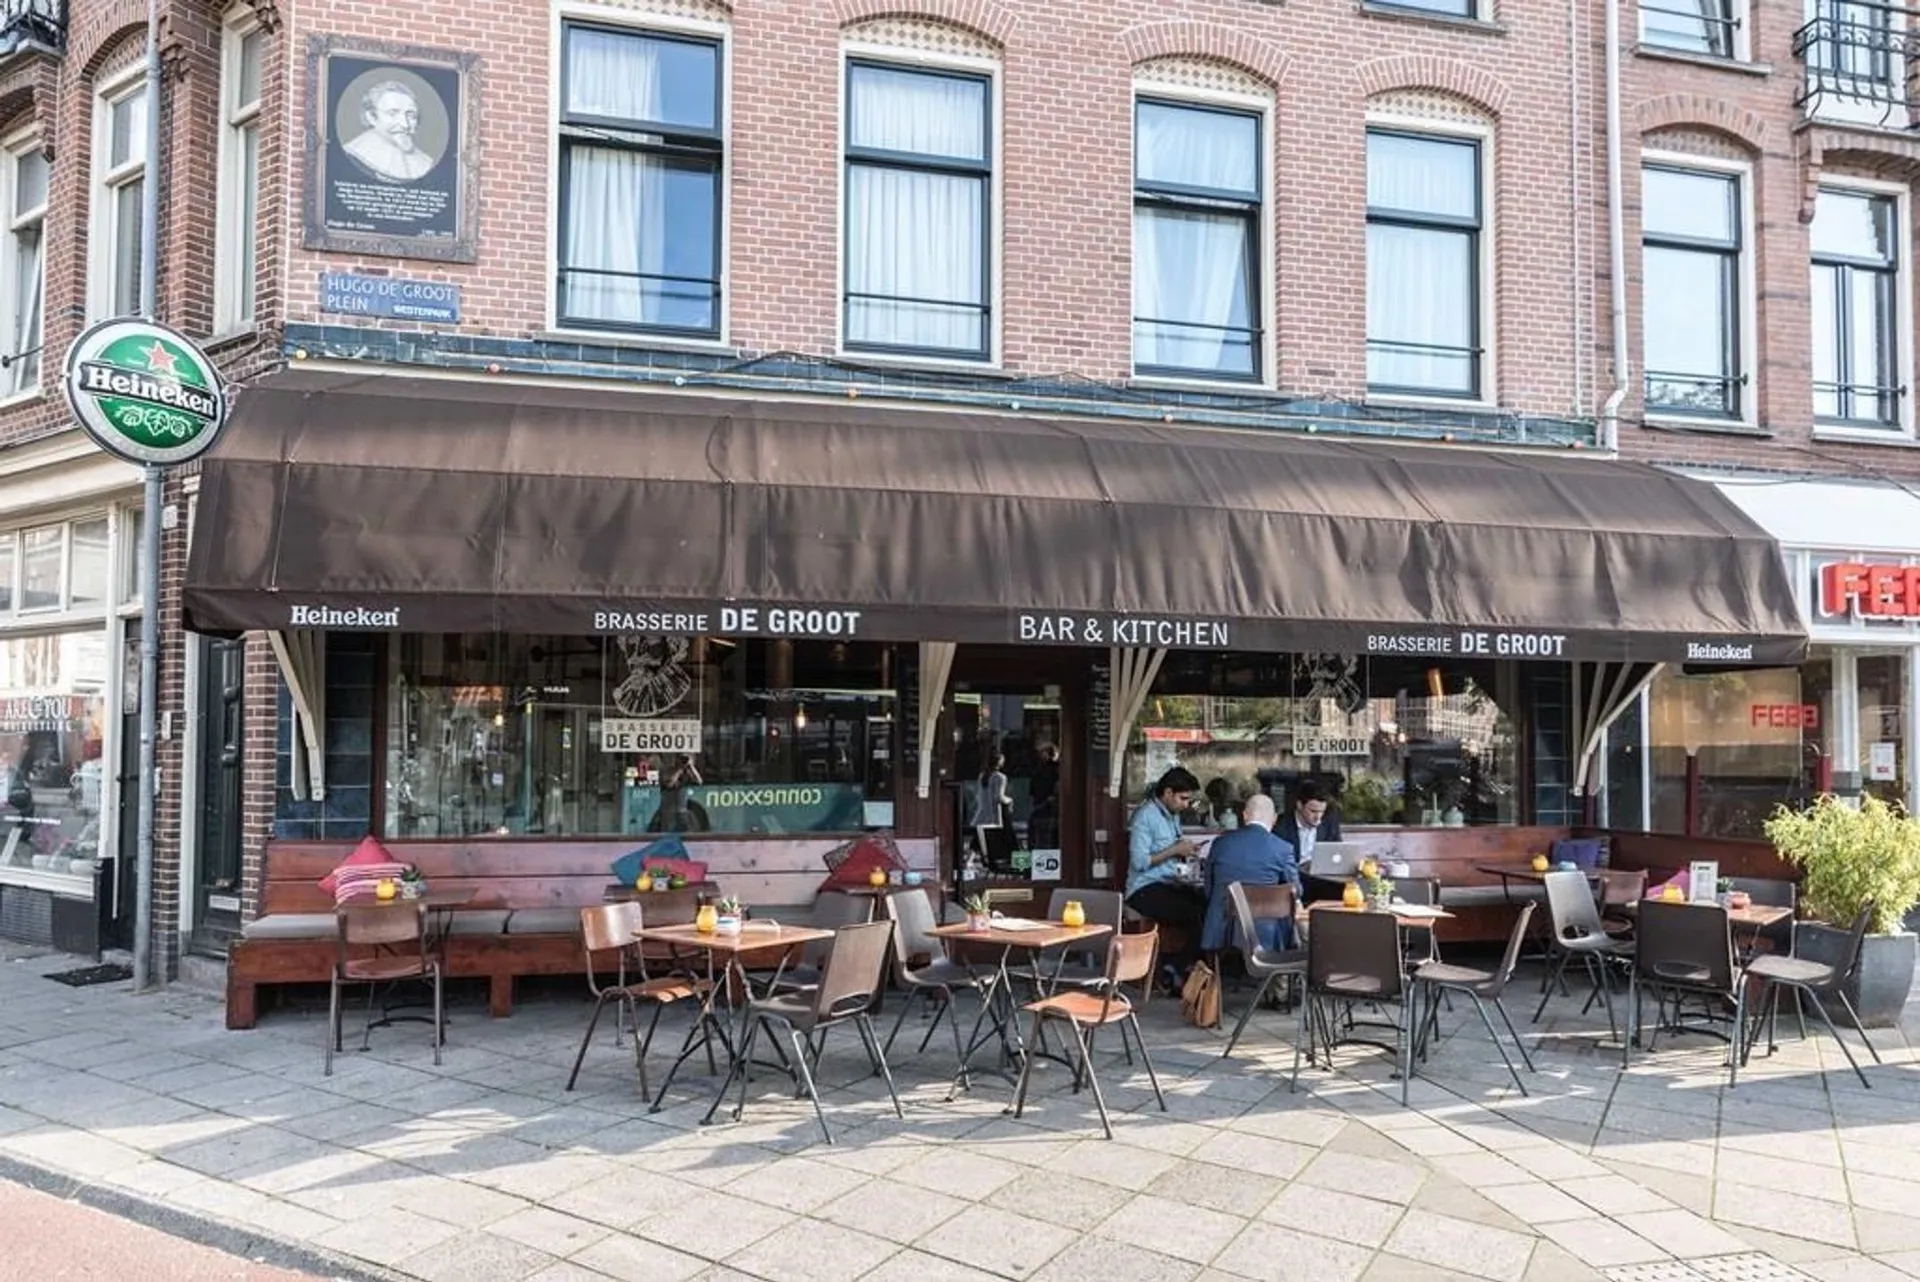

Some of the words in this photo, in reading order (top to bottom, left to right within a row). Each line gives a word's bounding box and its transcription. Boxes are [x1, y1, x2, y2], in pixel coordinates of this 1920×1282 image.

[327, 277, 374, 294] HUGO
[378, 282, 398, 296] DE
[403, 285, 453, 301] GROOT
[327, 294, 369, 311] PLEIN
[86, 364, 215, 417] Heineken
[290, 605, 400, 626] Heineken
[594, 612, 708, 631] BRASSERIE
[720, 608, 759, 631] DE
[768, 610, 861, 635] GROOT
[1020, 615, 1076, 641] BAR
[1083, 618, 1103, 642] &
[1113, 619, 1228, 646] KITCHEN
[1367, 635, 1452, 653] BRASSERIE
[1460, 633, 1490, 654] DE
[1496, 634, 1566, 656] GROOT
[1687, 642, 1753, 660] Heineken
[606, 733, 631, 749] DE
[636, 733, 697, 749] GROOT
[1296, 739, 1316, 753] DE
[1320, 739, 1366, 753] GROOT
